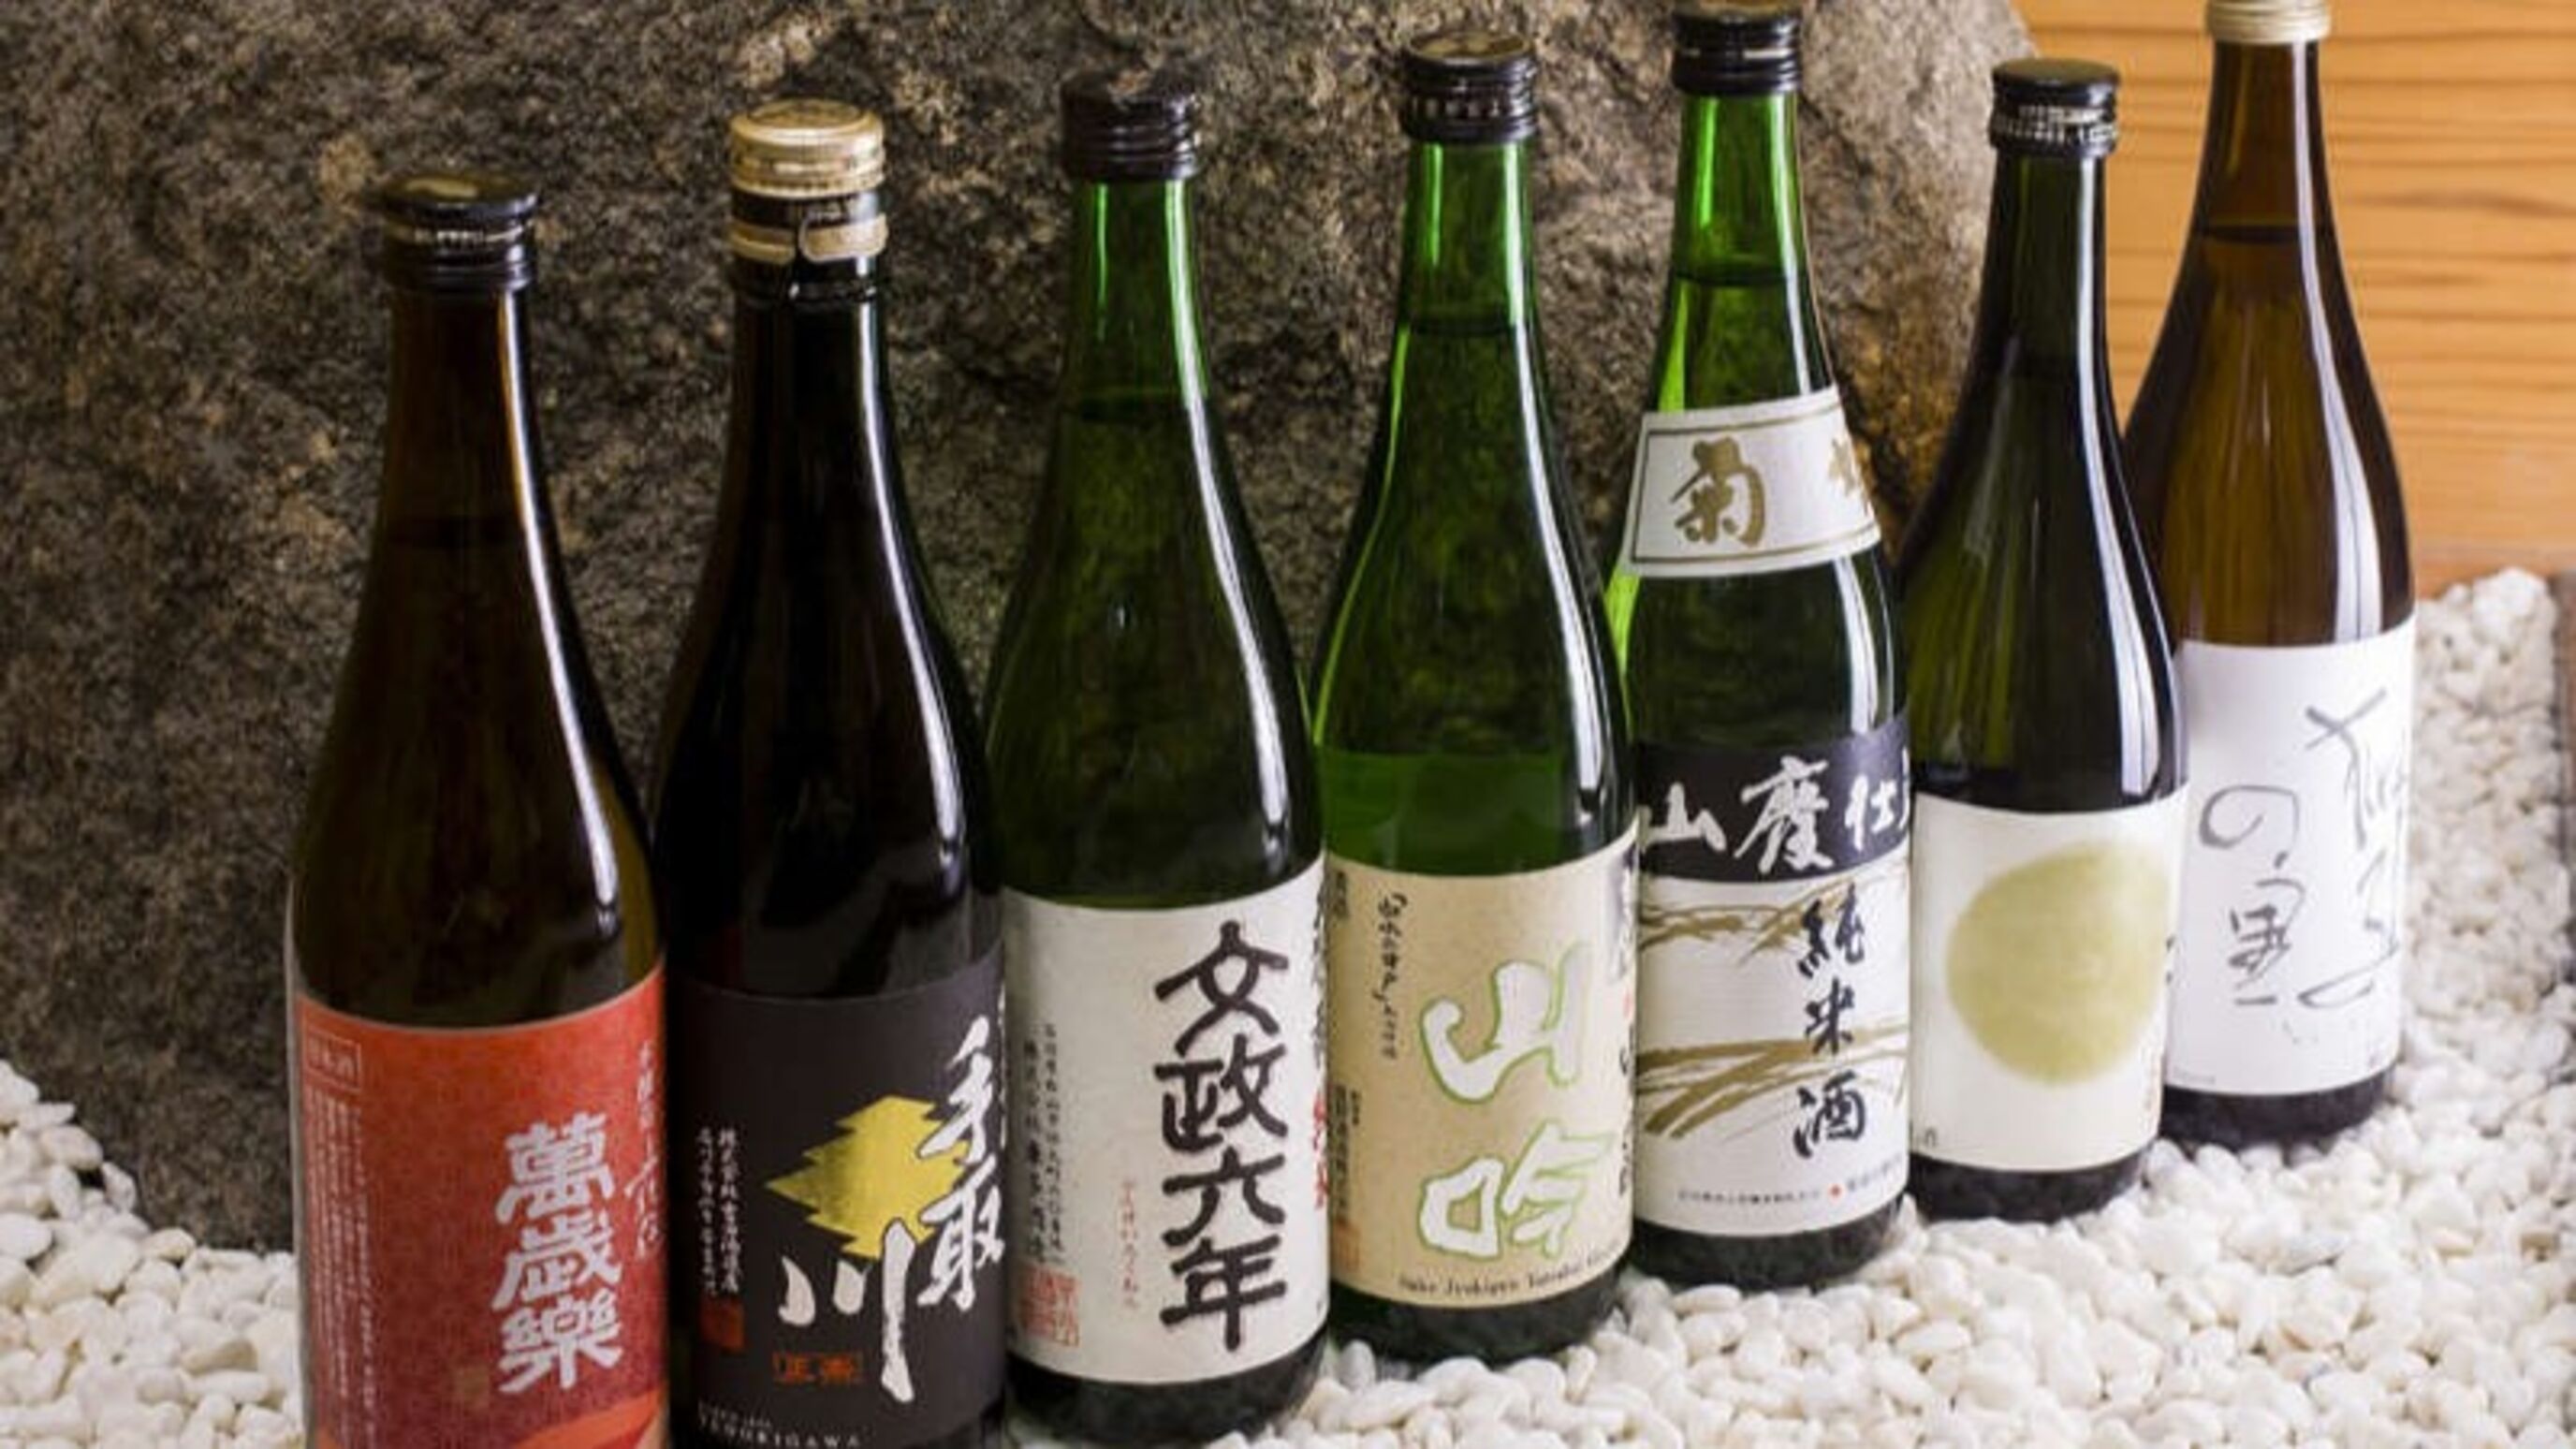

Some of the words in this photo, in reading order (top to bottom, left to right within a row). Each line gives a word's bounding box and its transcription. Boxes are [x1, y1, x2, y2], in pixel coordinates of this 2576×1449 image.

[1153, 919, 1289, 1354] 文政六年
[1419, 940, 1617, 1262] 山吟
[1792, 882, 1867, 1159] 純米酒
